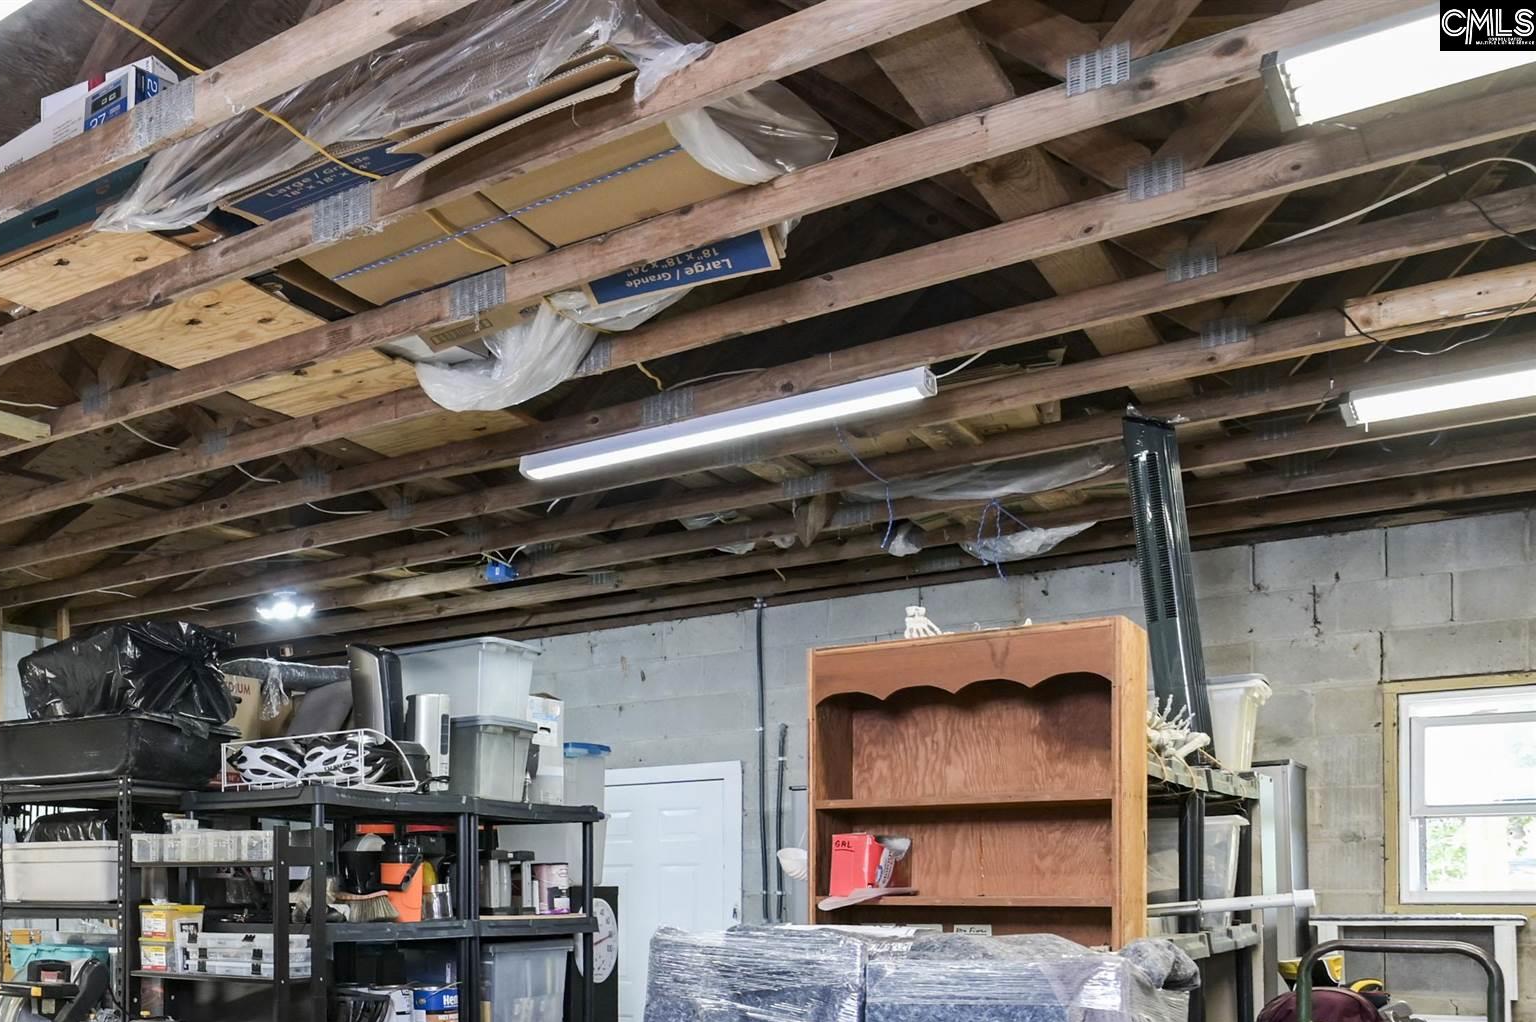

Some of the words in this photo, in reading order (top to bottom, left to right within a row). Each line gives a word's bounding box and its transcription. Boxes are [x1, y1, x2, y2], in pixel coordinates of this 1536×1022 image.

[266, 177, 312, 198] Large
[659, 253, 683, 268] 18"
[697, 247, 720, 261] 18"
[684, 258, 733, 276] Large
[626, 273, 672, 288] Grande
[442, 994, 459, 1006] Hen
